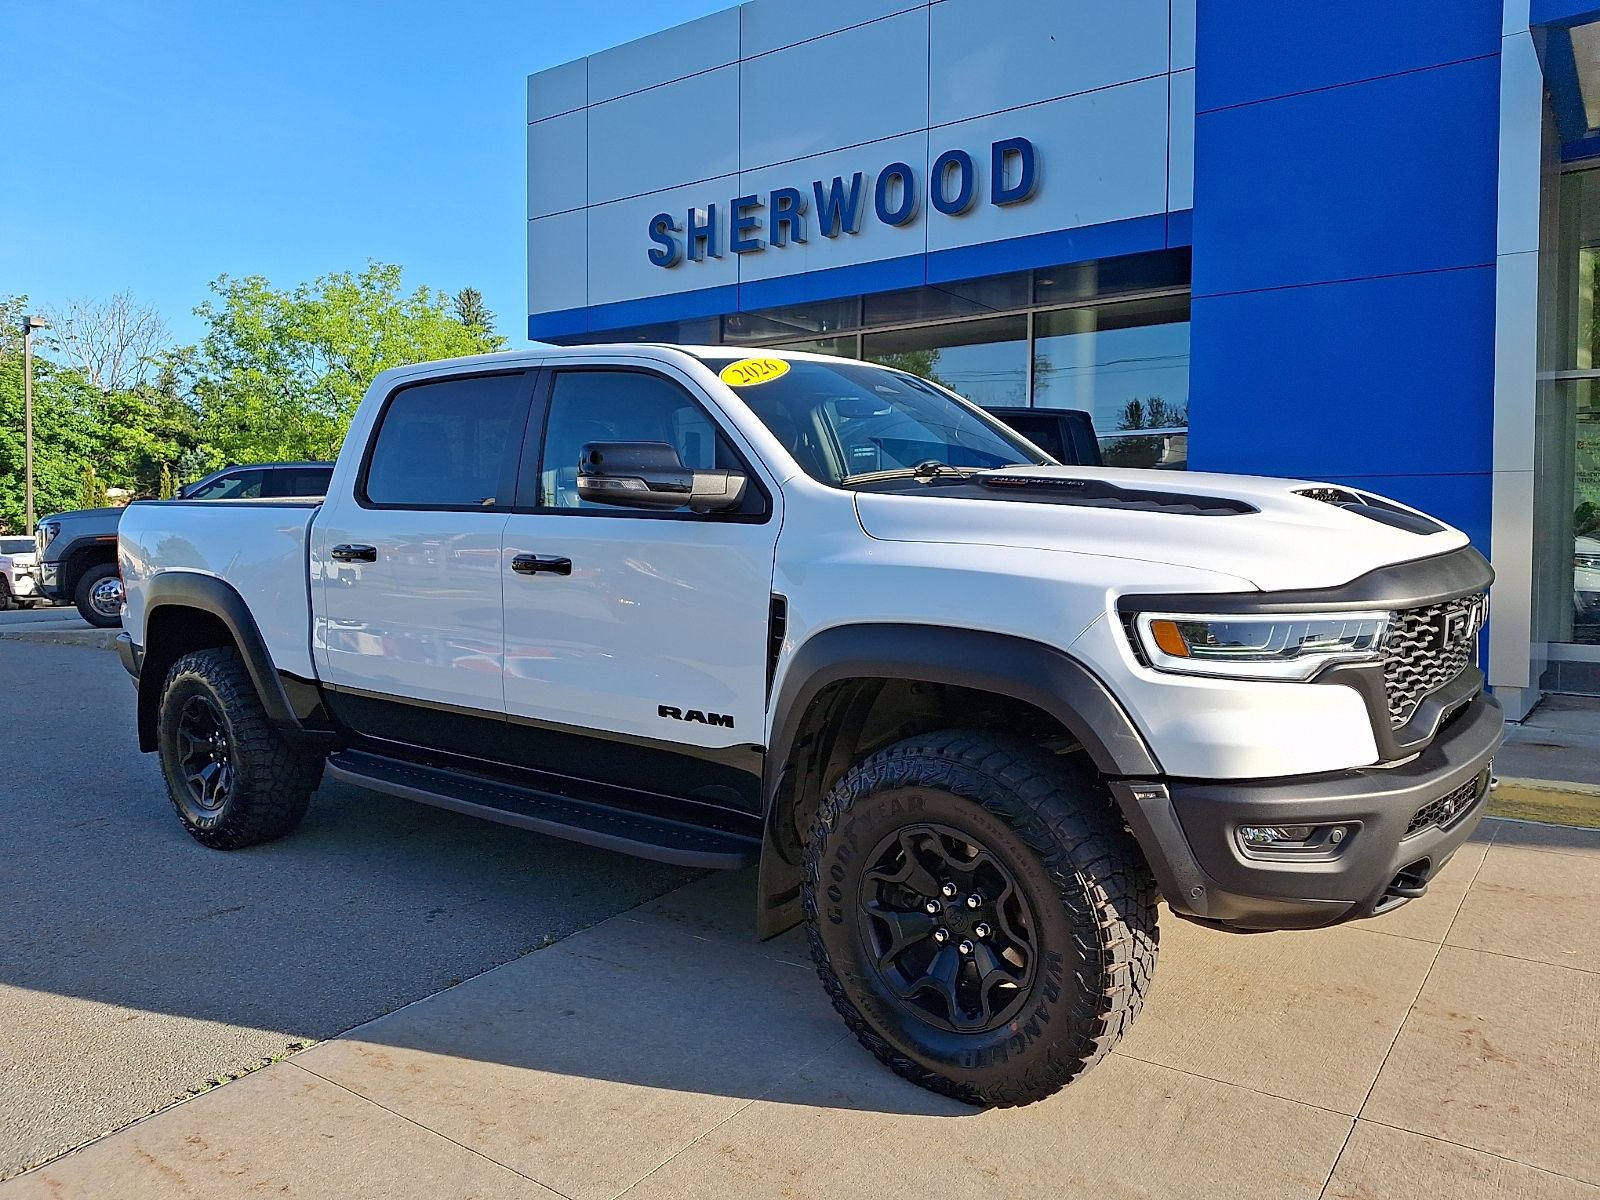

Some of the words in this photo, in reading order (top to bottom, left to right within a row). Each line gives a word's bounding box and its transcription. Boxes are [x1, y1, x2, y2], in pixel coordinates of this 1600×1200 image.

[647, 136, 1038, 268] SHERWOOD
[732, 360, 778, 383] 2026
[658, 704, 735, 729] RAM
